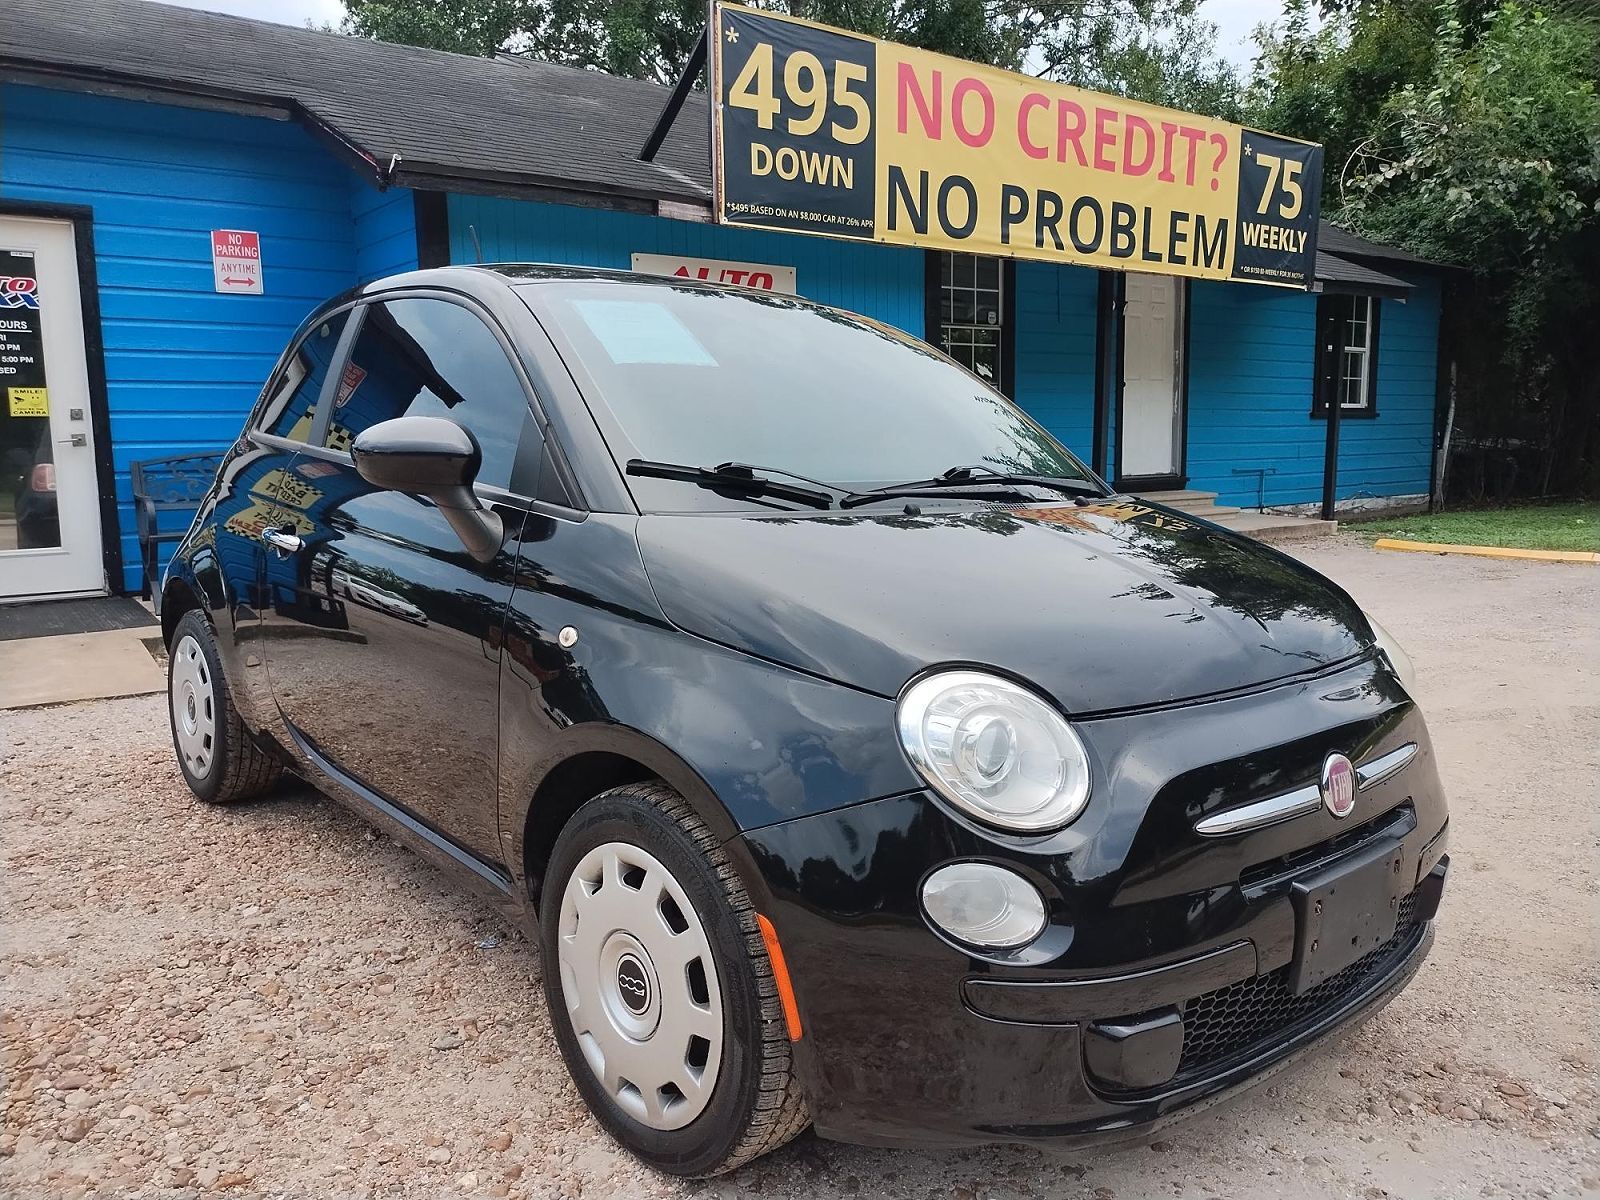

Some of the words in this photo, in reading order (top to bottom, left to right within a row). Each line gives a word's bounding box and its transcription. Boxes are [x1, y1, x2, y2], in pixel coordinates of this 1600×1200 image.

[897, 61, 995, 149] NO
[1017, 92, 1229, 192] CREDIT?
[750, 142, 854, 190] DOWN
[750, 204, 774, 216] BASED
[775, 208, 787, 218] ON
[788, 210, 799, 219] AN
[800, 211, 822, 222] $8,000
[822, 214, 836, 224] CAR
[837, 216, 846, 225] AT
[846, 217, 860, 227] 26%
[860, 219, 874, 229] APR
[886, 164, 979, 240] NO
[1000, 183, 1230, 270] PROBLEM
[215, 244, 258, 258] PARKING
[228, 233, 243, 245] NO
[1242, 221, 1308, 254] WEEKLY
[220, 262, 256, 275] ANYTIME
